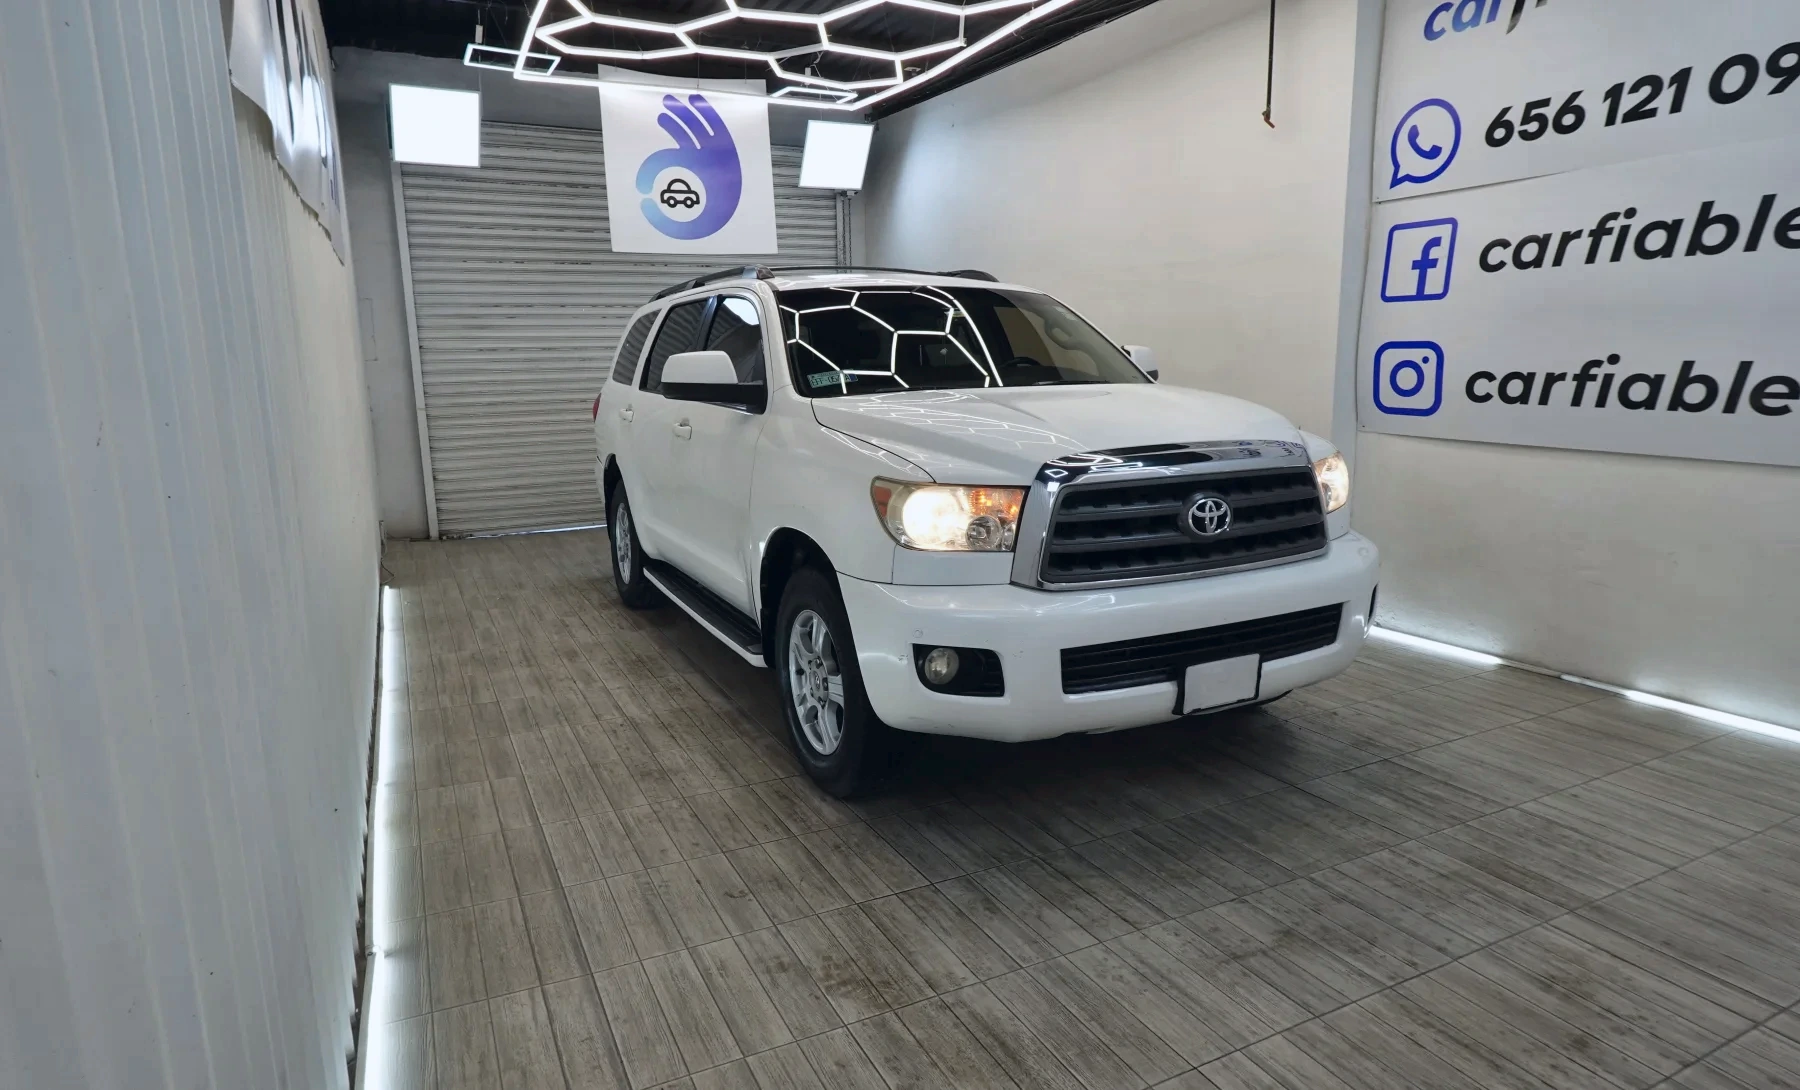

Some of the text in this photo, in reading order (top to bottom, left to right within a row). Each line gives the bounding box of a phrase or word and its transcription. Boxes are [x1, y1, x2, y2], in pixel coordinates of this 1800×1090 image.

[1484, 42, 1800, 148] 656 121 09
[1478, 194, 1800, 273] carfiable
[1465, 353, 1800, 417] carfiable
